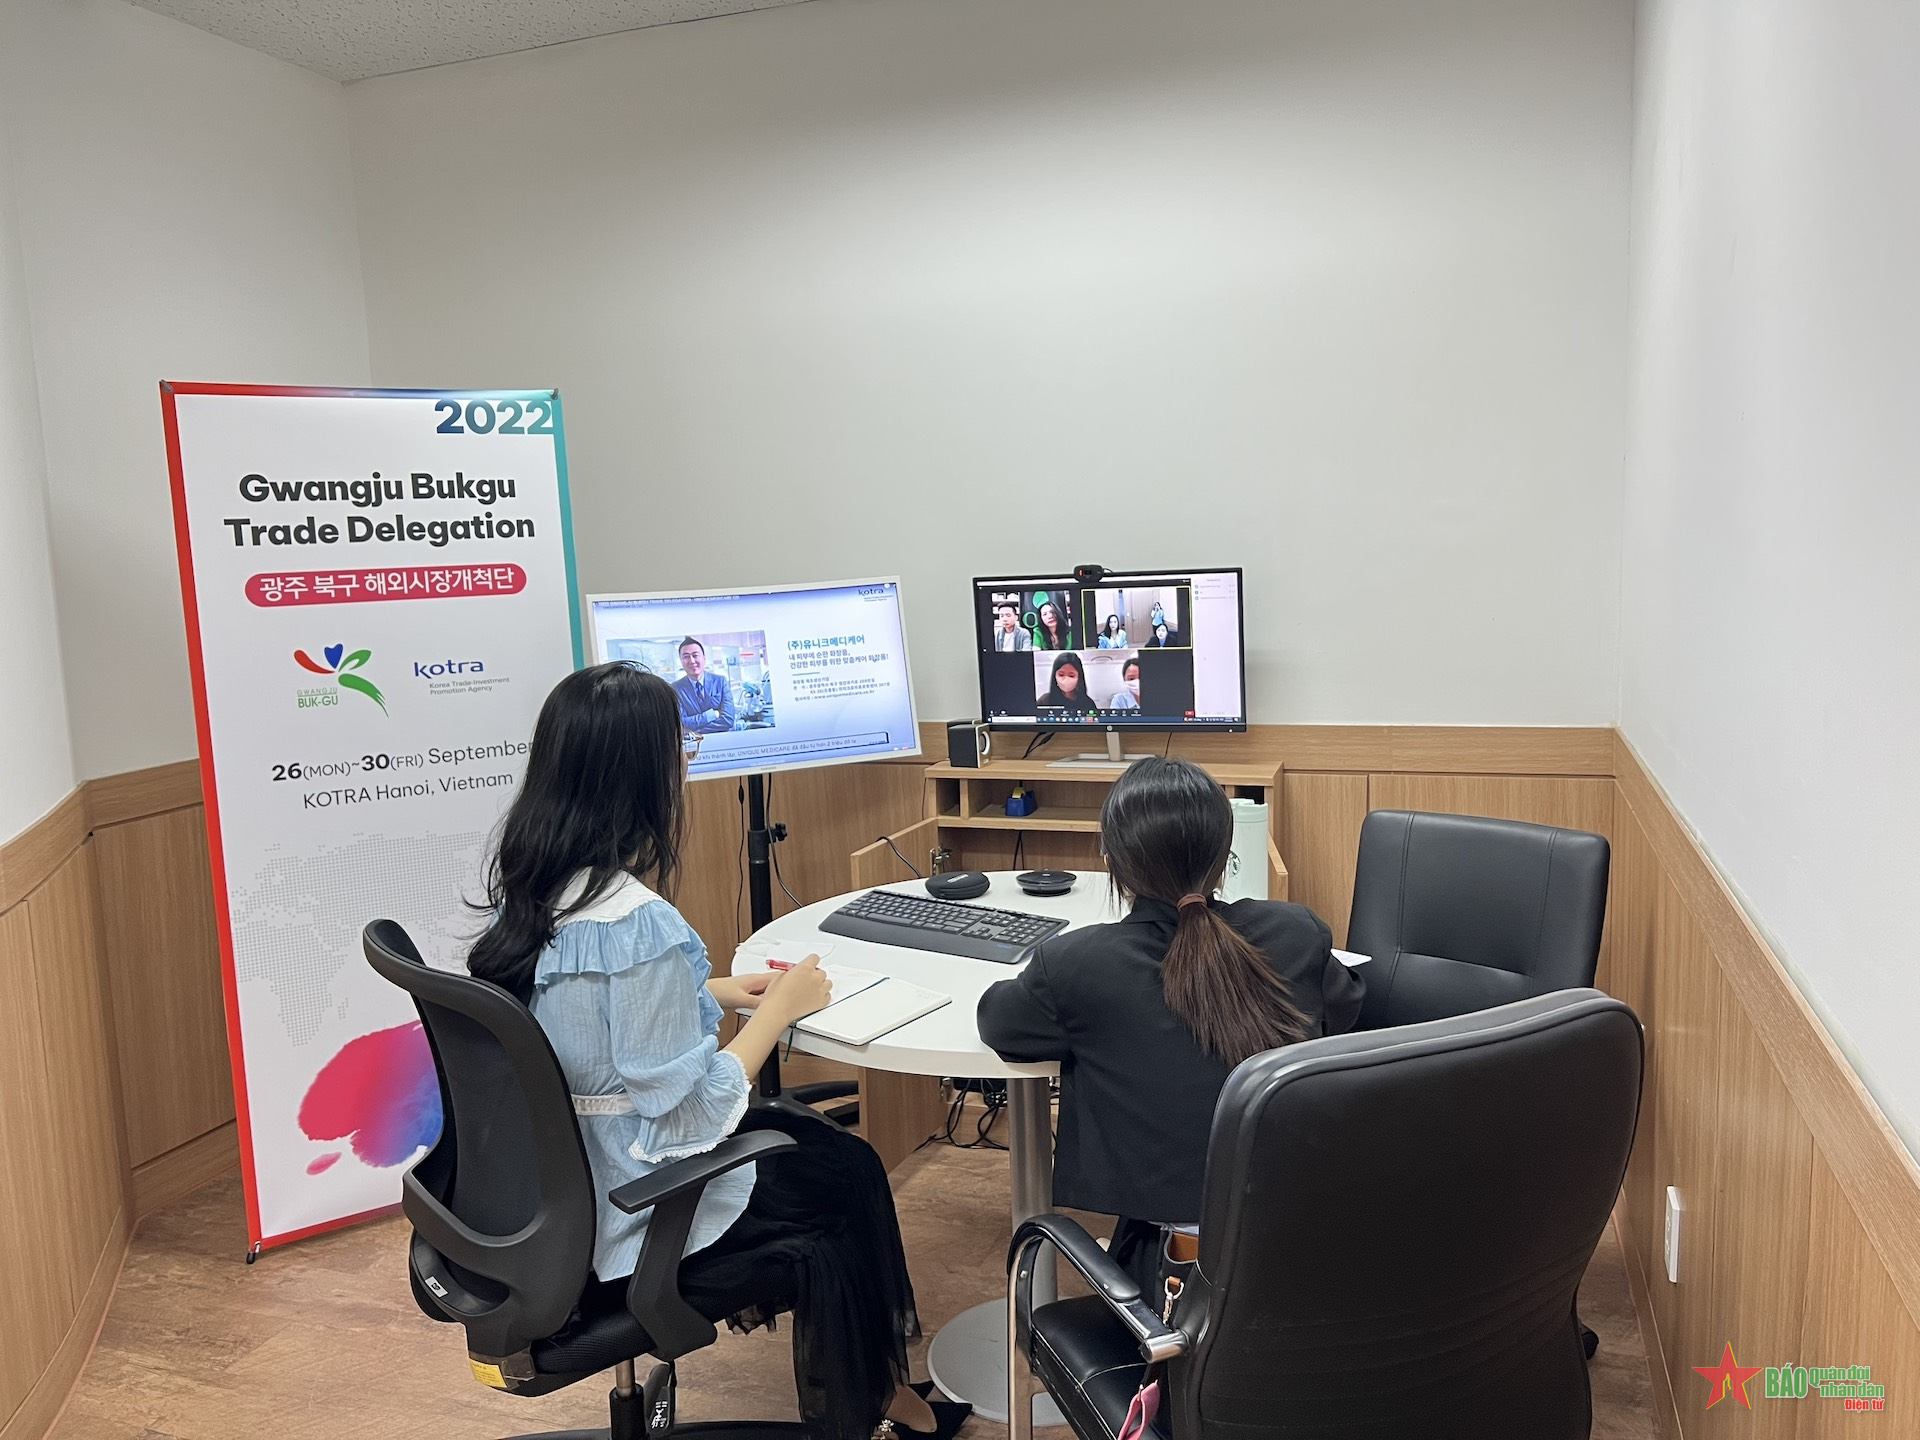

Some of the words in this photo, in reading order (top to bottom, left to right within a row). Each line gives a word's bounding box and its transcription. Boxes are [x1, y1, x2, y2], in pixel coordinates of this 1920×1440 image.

[435, 399, 553, 434] 2022
[239, 471, 404, 508] Gwangju
[410, 472, 516, 505] Bukgu
[223, 516, 339, 546] Trade
[346, 511, 536, 547] Delegation
[259, 576, 309, 602] 광주
[313, 574, 360, 597] 북구
[364, 567, 515, 596] 해외시장개척단
[858, 588, 884, 596] kotra
[414, 659, 485, 679] kotra
[429, 681, 451, 689] Korea
[452, 677, 510, 687] Trade-Investment
[430, 687, 467, 696] Promotion
[467, 685, 493, 695] Agency
[297, 688, 338, 696] GWANGJU
[297, 695, 339, 708] BUK-GU
[737, 749, 760, 757] UNIQUE
[760, 745, 791, 754] MEDICARE
[303, 788, 372, 809] KOTRA
[376, 779, 435, 800] Hanoi,
[439, 772, 514, 792] Vietnam
